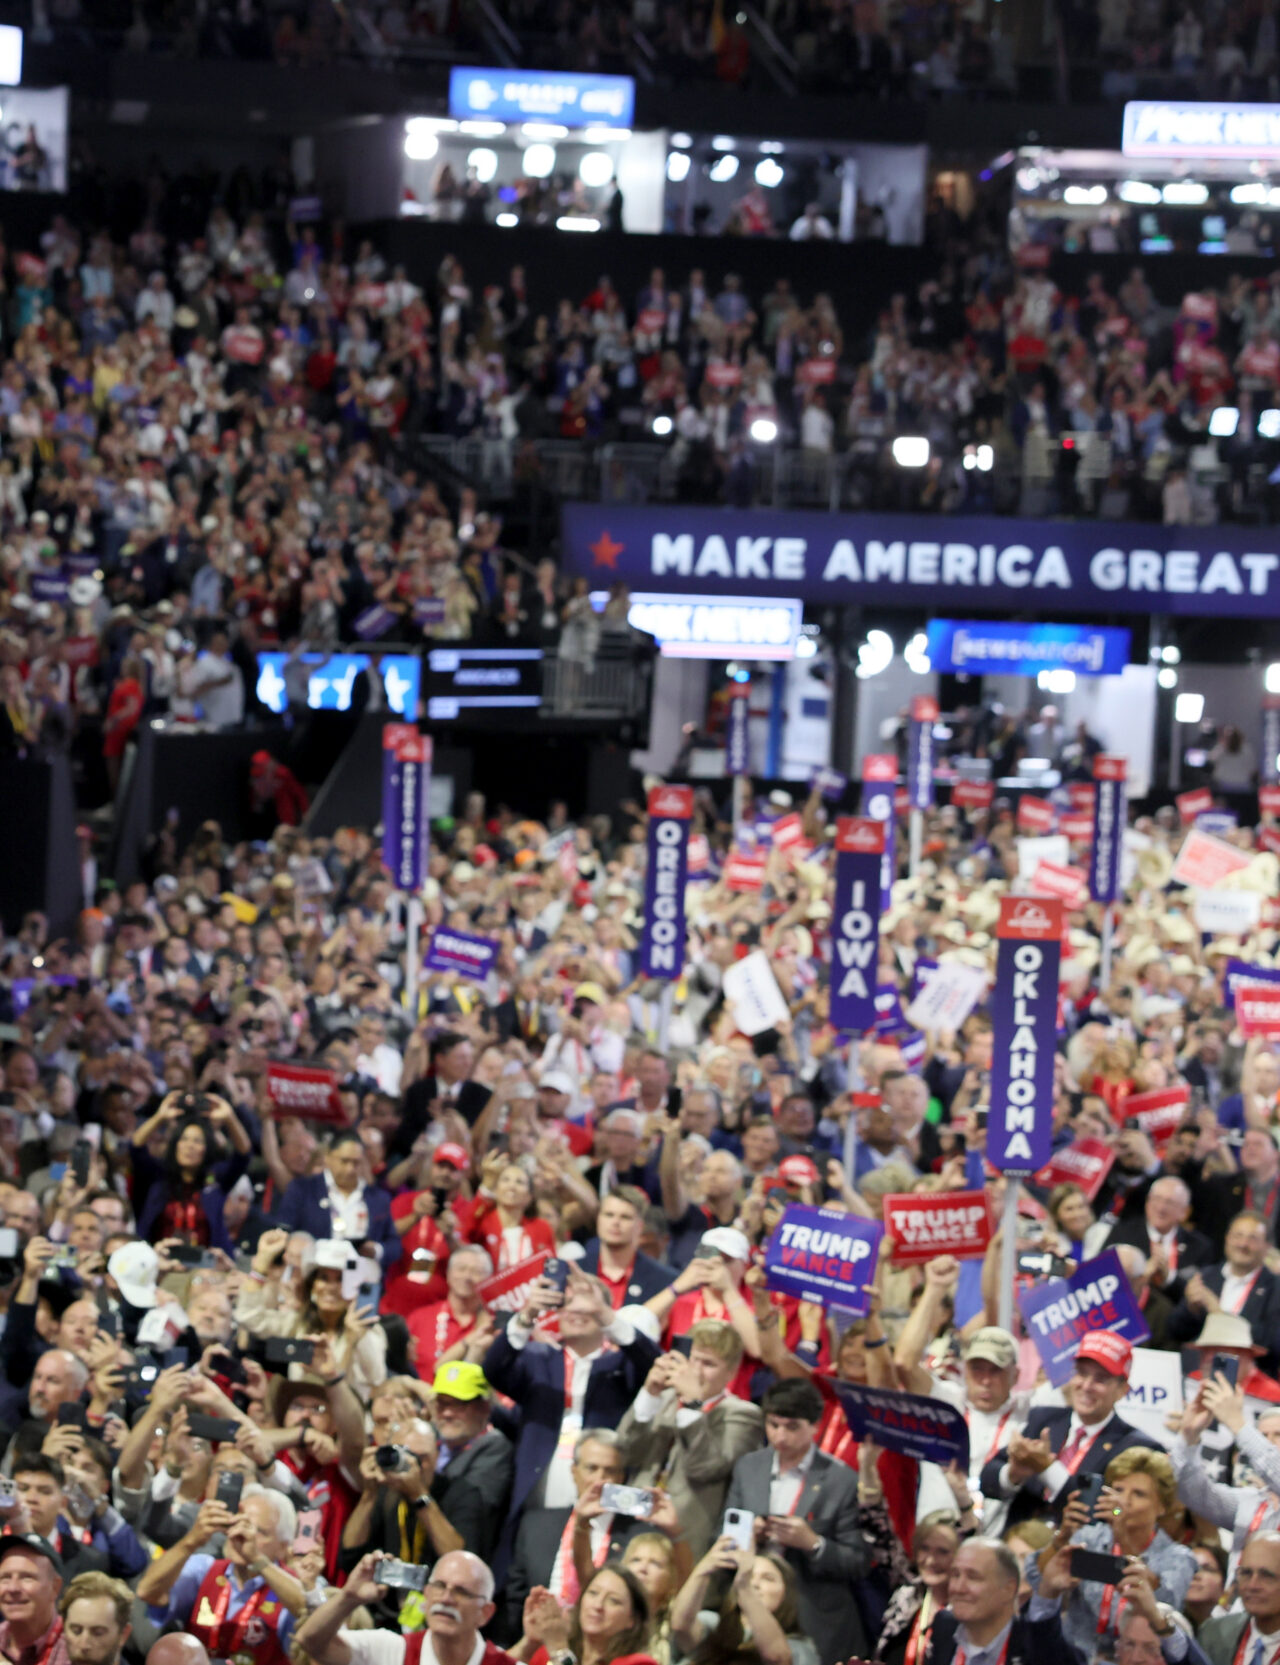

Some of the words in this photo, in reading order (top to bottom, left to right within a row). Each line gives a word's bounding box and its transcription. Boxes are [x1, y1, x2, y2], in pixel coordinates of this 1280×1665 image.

[651, 532, 807, 581] MAKE
[822, 538, 1073, 590] AMERICA
[1089, 547, 1279, 596] GREAT
[650, 819, 683, 971] OREGON
[836, 880, 876, 999] IOWA
[1003, 944, 1044, 1161] OKLAHOMA
[890, 1205, 986, 1232] TRUMP
[902, 1222, 978, 1245] VANCE
[779, 1222, 872, 1264] TRUMP
[781, 1245, 855, 1282] VANCE
[1031, 1274, 1120, 1336] TRUMP
[1048, 1301, 1119, 1349] VANCE
[841, 1388, 957, 1425] TRUMP
[865, 1404, 953, 1439] VANCE
